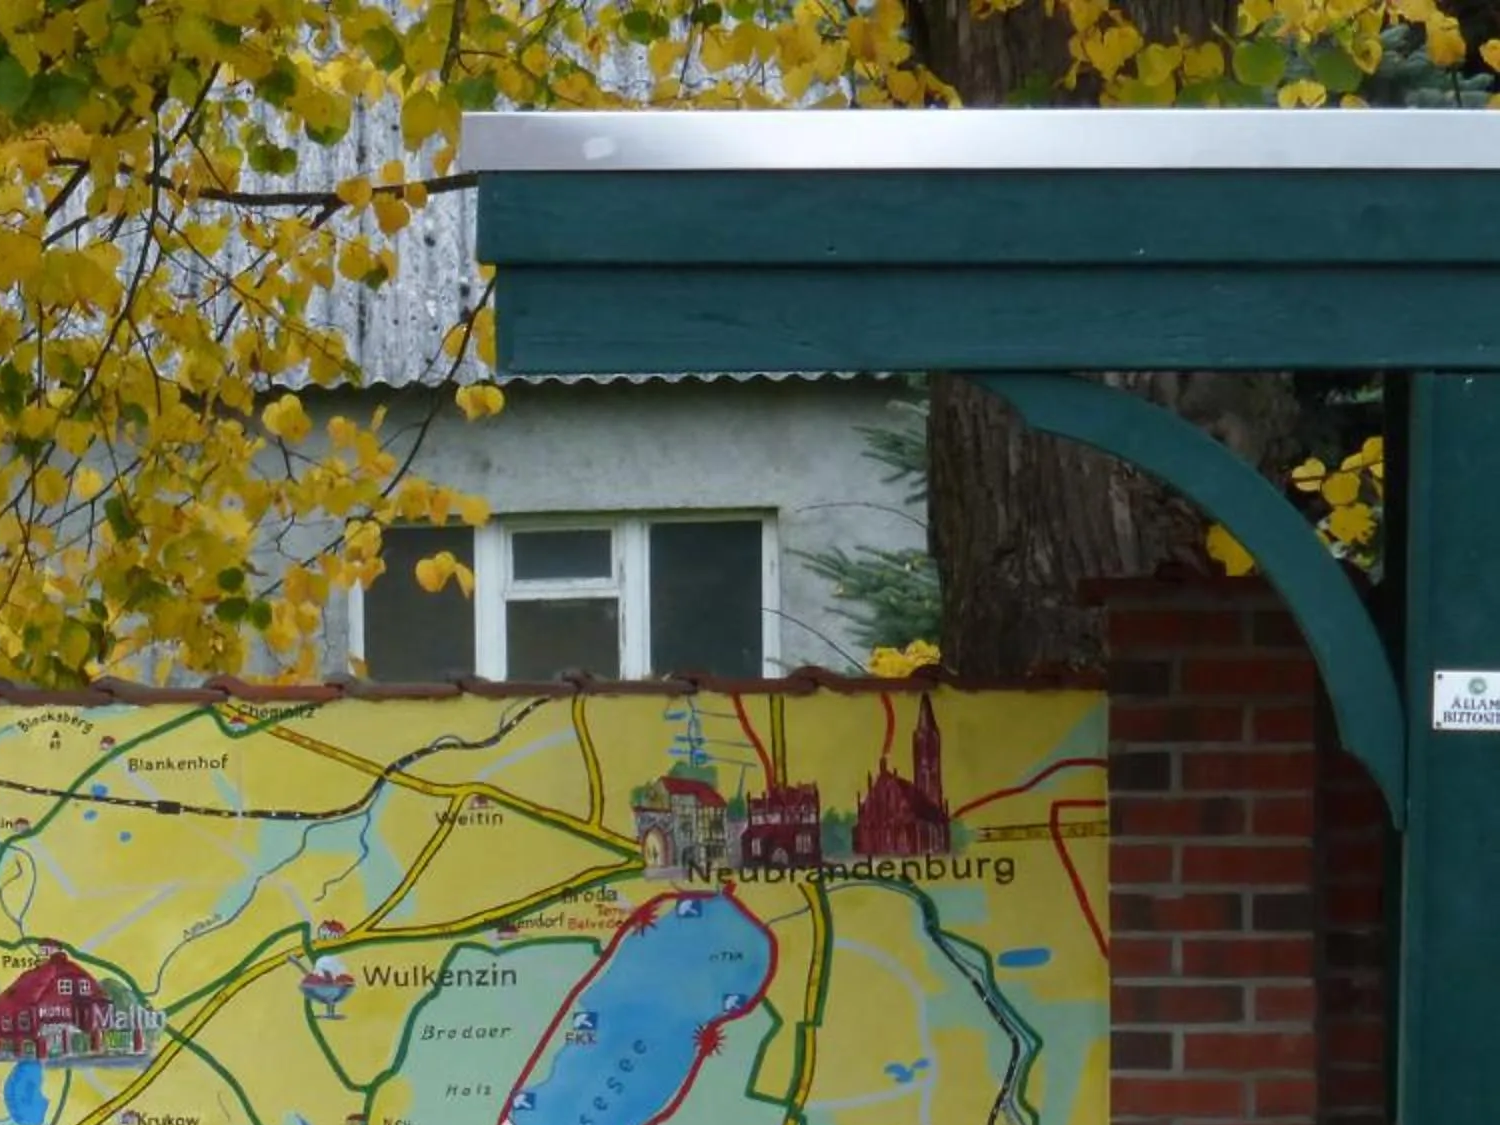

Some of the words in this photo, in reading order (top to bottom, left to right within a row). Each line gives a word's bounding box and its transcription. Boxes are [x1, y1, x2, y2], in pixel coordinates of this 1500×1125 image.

[128, 754, 228, 773] Blankenhof
[435, 810, 503, 827] Weitin
[687, 855, 1016, 884] Neubrandenburg
[363, 963, 518, 988] Wulkenzin
[565, 1031, 597, 1046] FKK
